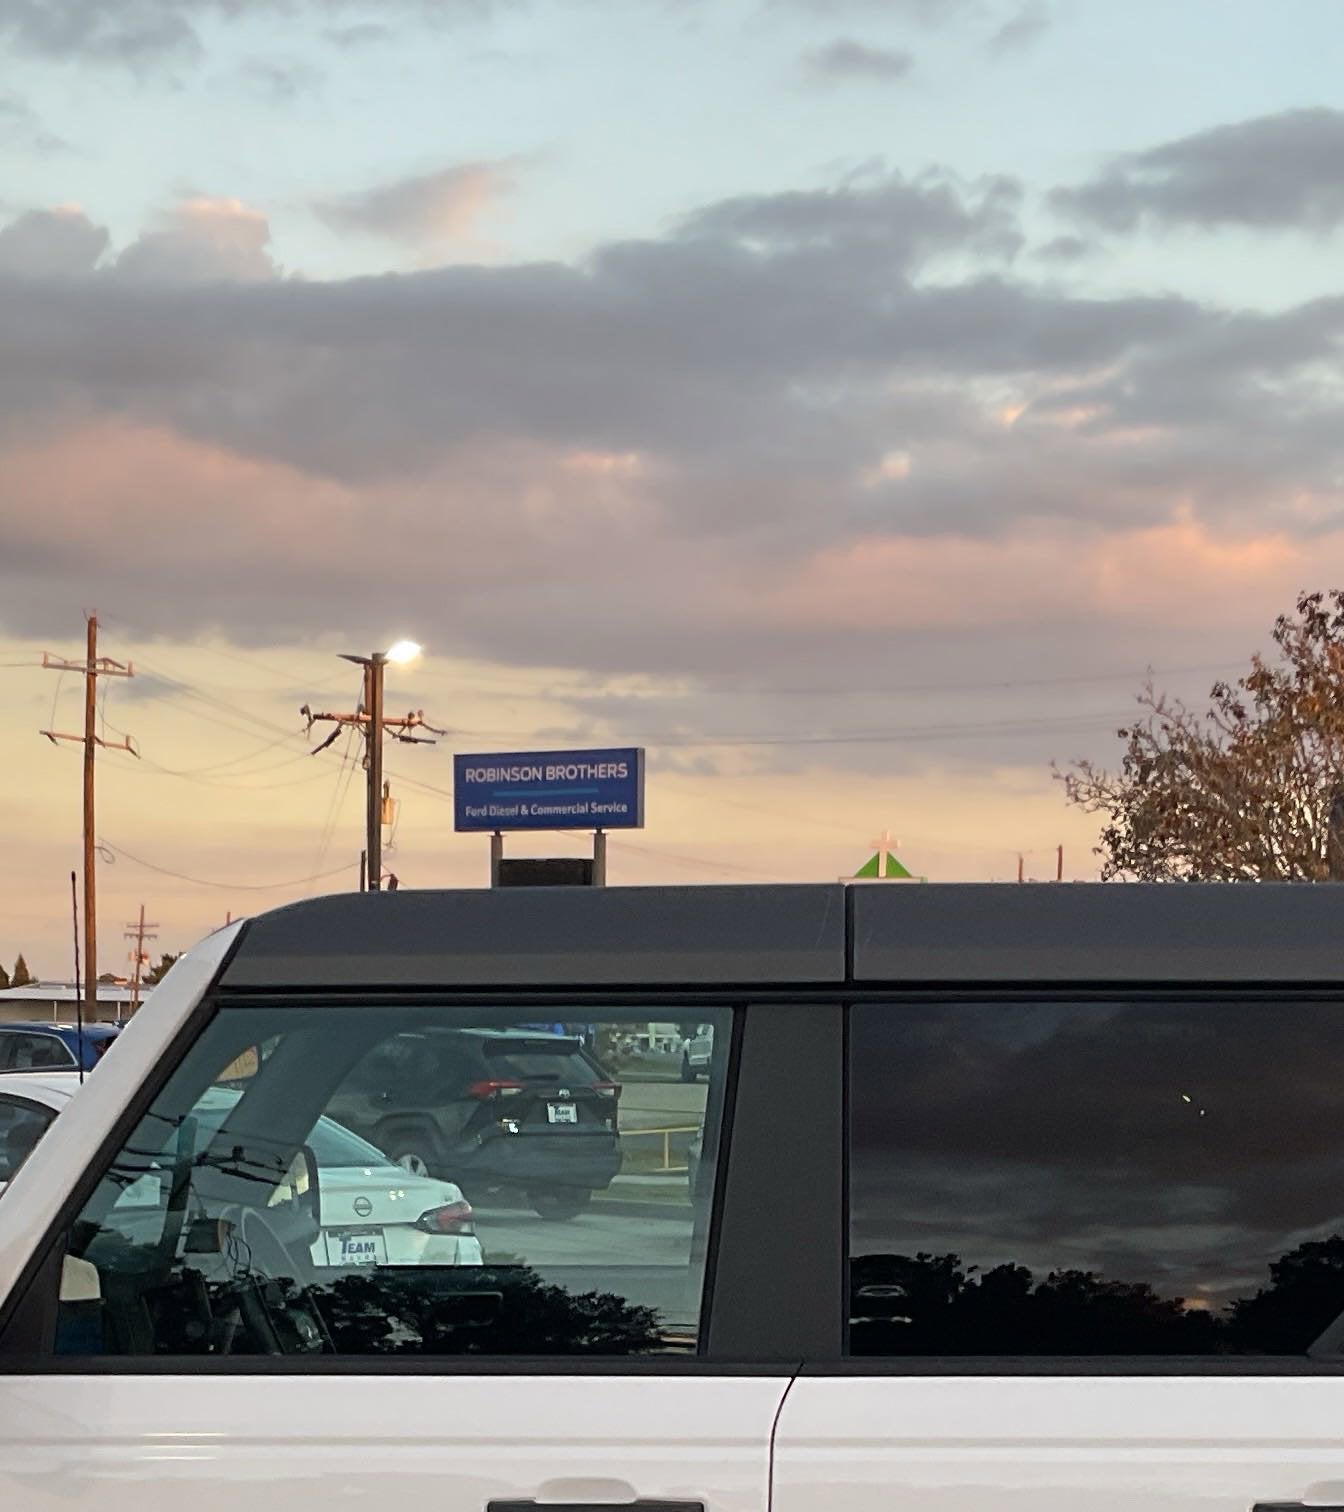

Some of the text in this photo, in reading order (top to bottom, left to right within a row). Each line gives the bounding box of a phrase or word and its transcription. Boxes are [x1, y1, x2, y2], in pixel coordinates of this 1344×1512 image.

[465, 763, 629, 784] ROBINSON BROTHERS
[465, 801, 628, 817] Ford Diesel & Commercial Service
[339, 1232, 376, 1254] TEAM
